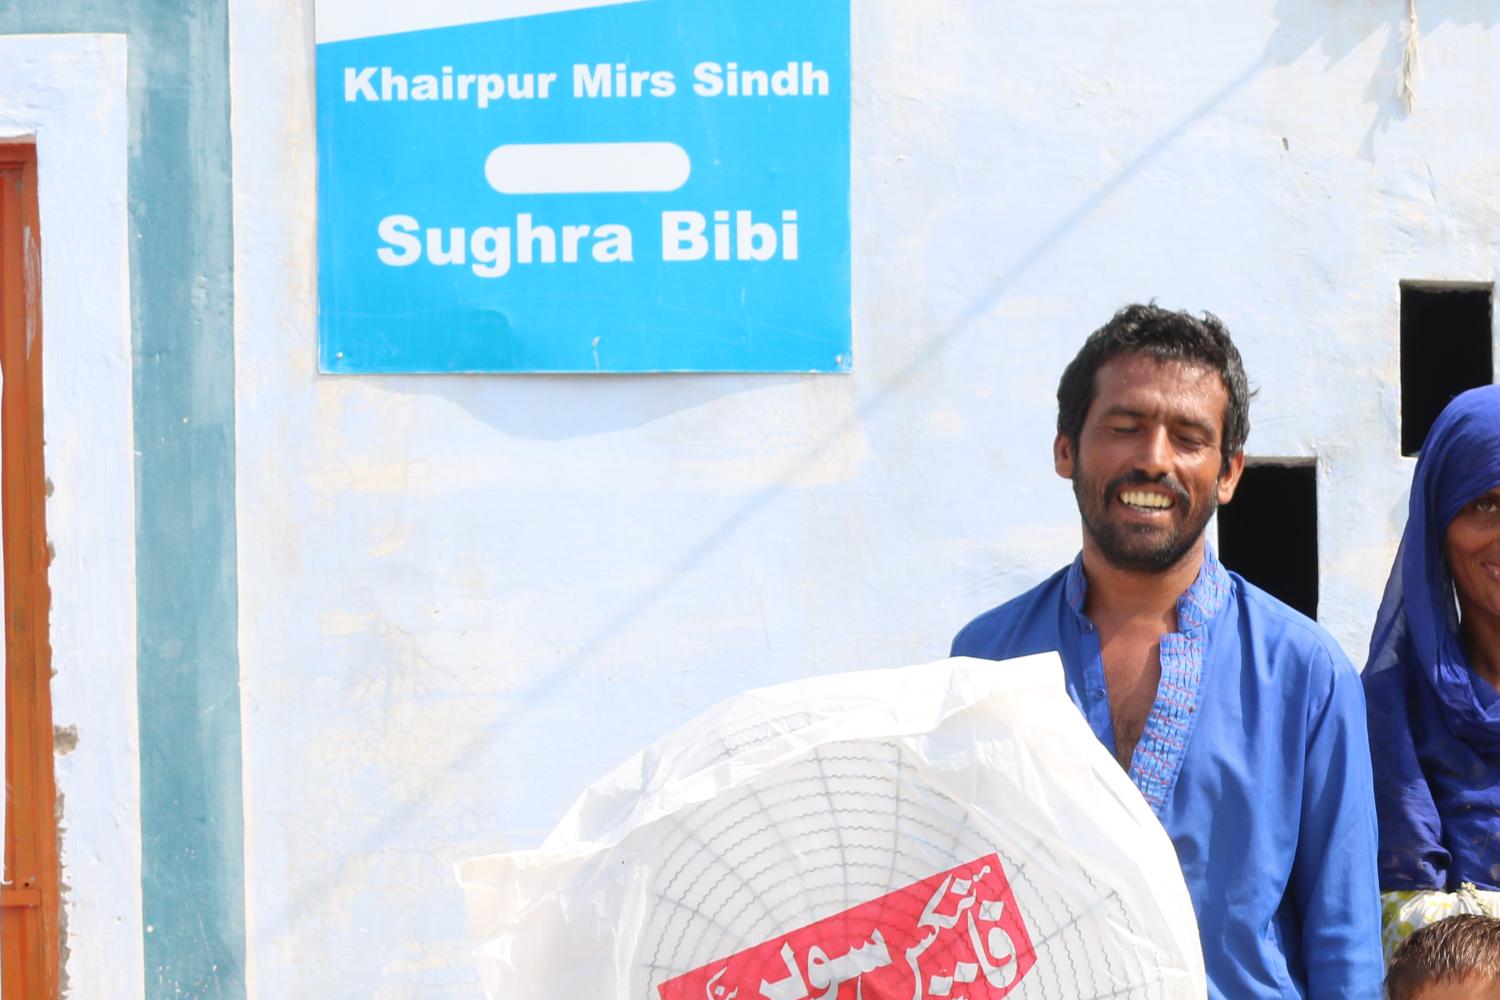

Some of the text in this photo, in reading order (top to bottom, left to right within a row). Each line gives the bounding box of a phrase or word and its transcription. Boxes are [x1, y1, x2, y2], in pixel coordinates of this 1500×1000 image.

[343, 61, 829, 108] Khairpur Mirs Sindh
[376, 210, 798, 278] Sughra Bibi
